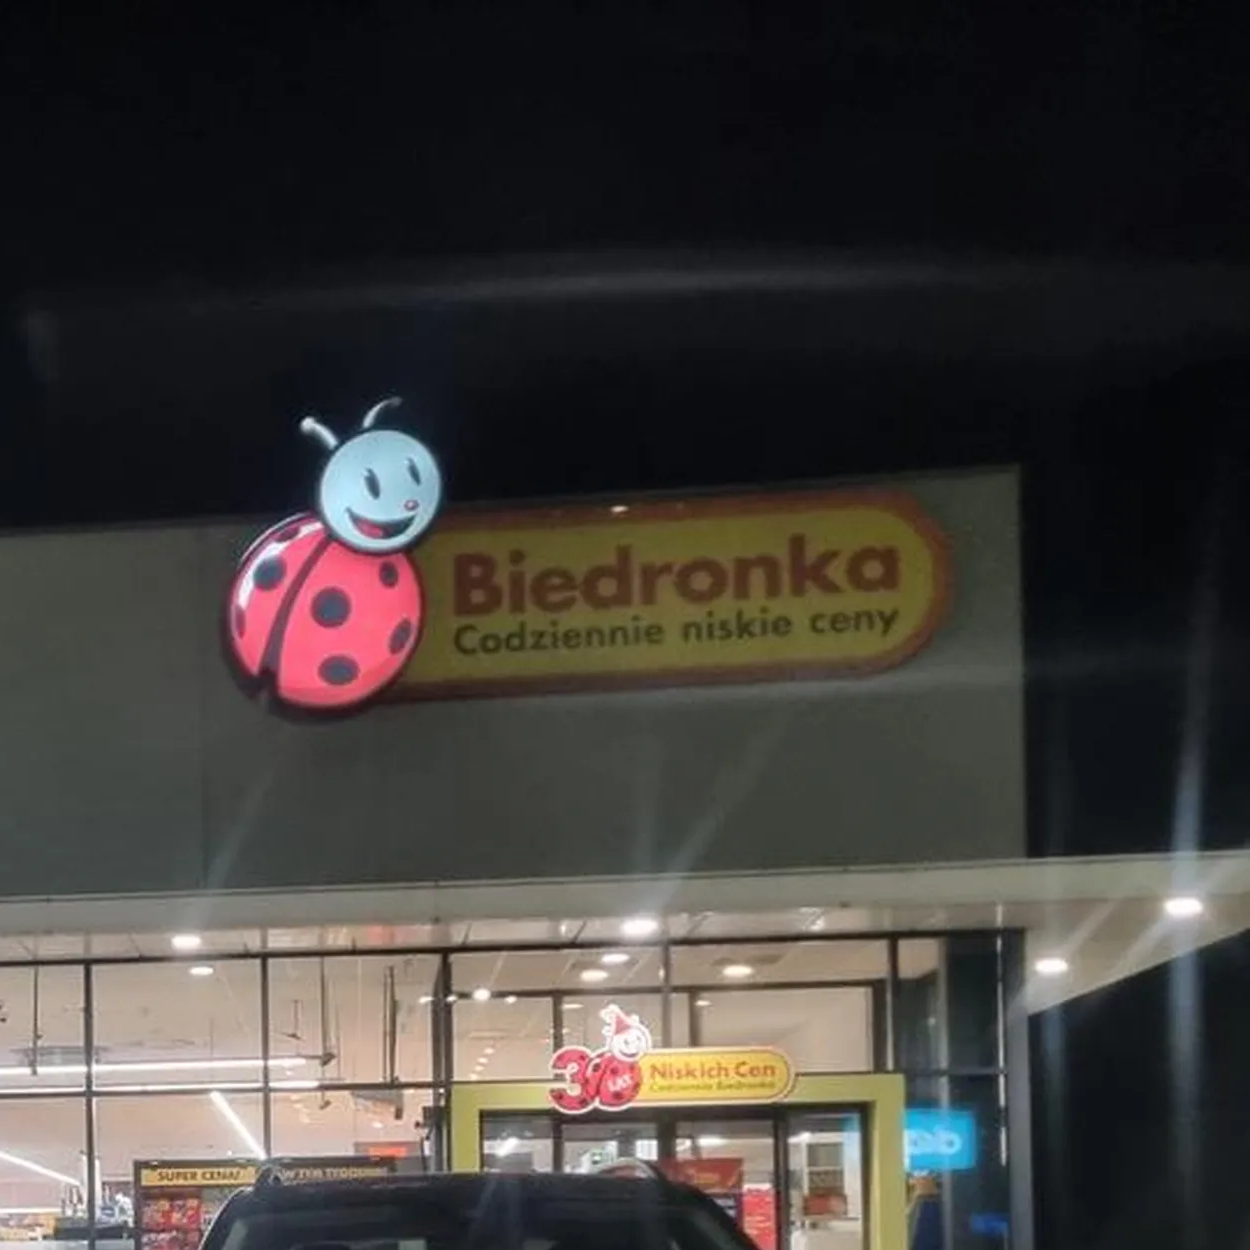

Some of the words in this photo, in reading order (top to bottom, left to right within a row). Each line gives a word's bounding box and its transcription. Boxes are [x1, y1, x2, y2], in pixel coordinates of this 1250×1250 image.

[453, 533, 901, 618] Biedronka
[453, 614, 664, 656] Codziennie
[682, 607, 793, 643] niskie
[808, 606, 899, 636] ceny
[549, 1047, 643, 1113] 30
[649, 1061, 729, 1080] Niskich
[157, 1171, 198, 1182] SUPER
